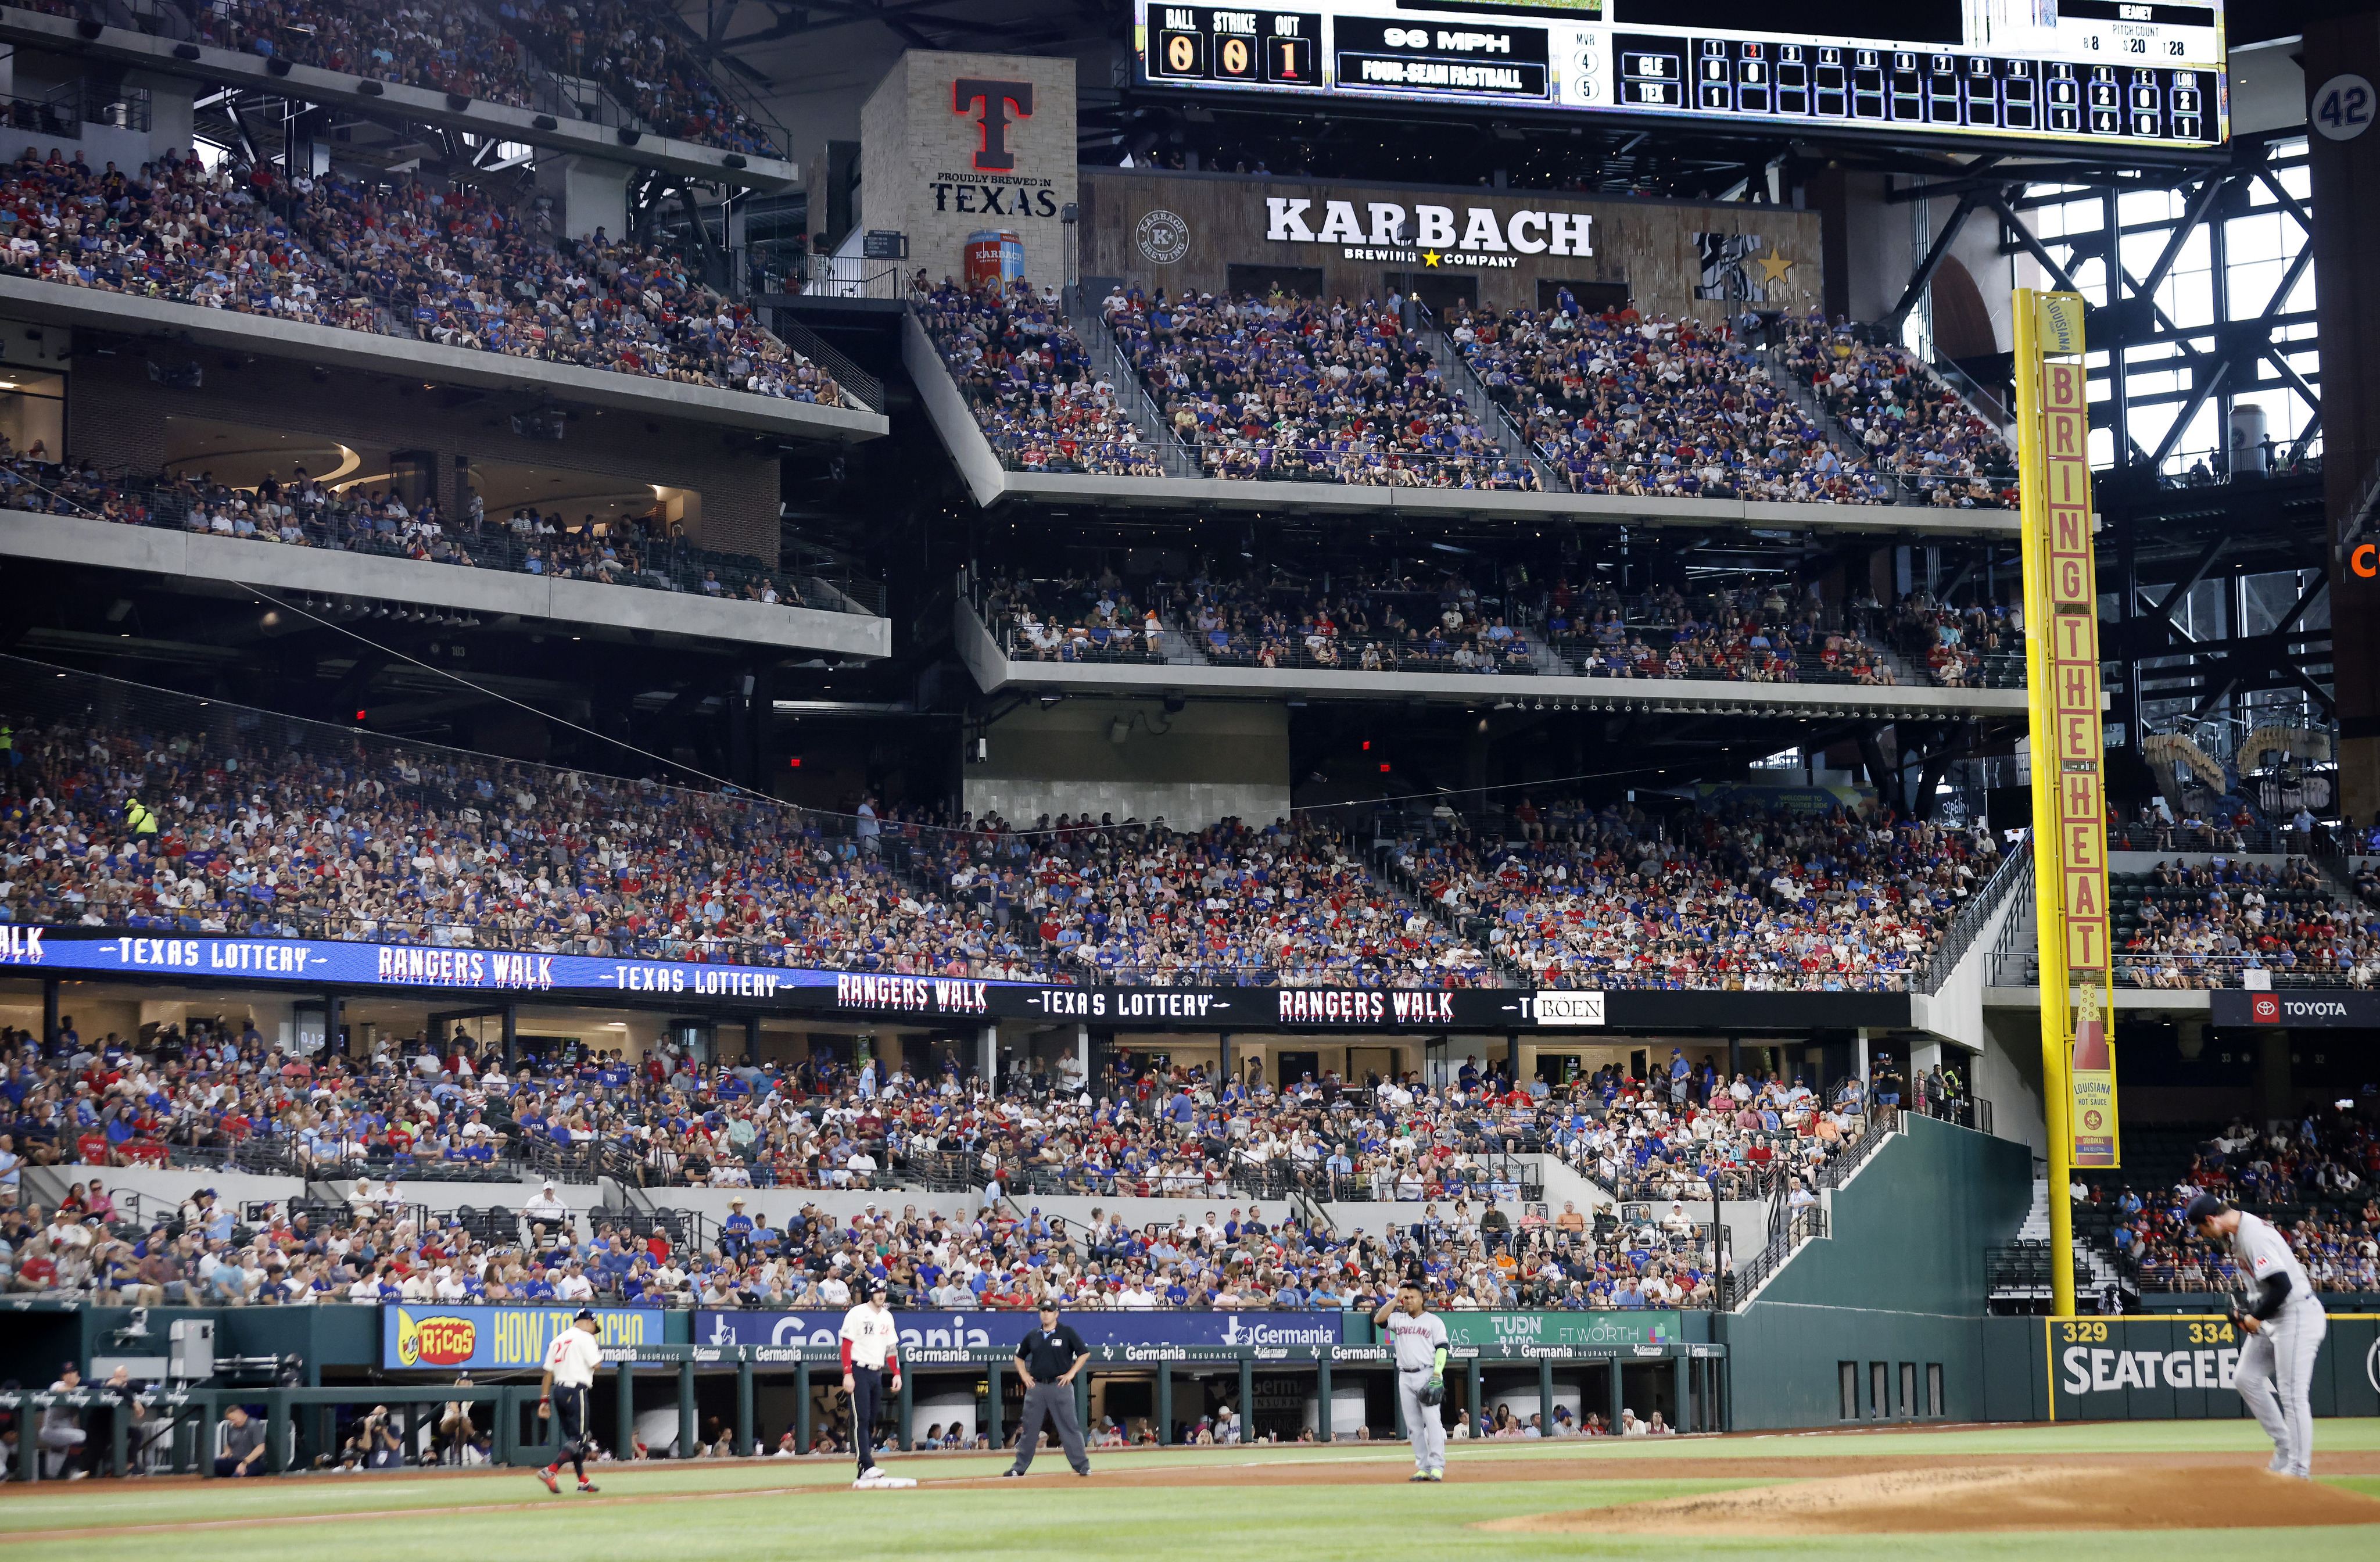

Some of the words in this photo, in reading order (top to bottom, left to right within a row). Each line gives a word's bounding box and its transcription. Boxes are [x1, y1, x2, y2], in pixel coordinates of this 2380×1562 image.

[1166, 9, 1196, 30] BALL
[1213, 13, 1256, 34] STRIKE
[1275, 16, 1299, 37] OUT
[2113, 24, 2134, 36] PITCH
[2135, 26, 2159, 37] COUNT
[1383, 27, 1429, 46] 96
[1437, 31, 1510, 53] MPH
[1576, 33, 1596, 46] MVR
[2092, 36, 2099, 50] 8
[2131, 38, 2146, 53] 20
[2170, 41, 2185, 56] 28
[1169, 35, 1193, 71] 0
[1223, 38, 1248, 74] 0
[1281, 42, 1298, 78] 1
[1582, 54, 1590, 69] 4
[1711, 42, 1717, 55] 1
[1750, 45, 1757, 57] 2
[1826, 49, 1833, 62] 4
[1940, 58, 1946, 70] 7
[2142, 70, 2148, 84] E
[2177, 72, 2193, 87] LOB
[1362, 59, 1450, 84] FOUR-SEAM
[1450, 65, 1522, 89] FASTBALL
[1639, 56, 1664, 76] CLE
[1709, 60, 1720, 80] 0
[1748, 63, 1759, 82] 0
[2059, 84, 2069, 102] 0
[2099, 87, 2110, 105] 2
[2139, 89, 2150, 108] 0
[2180, 92, 2189, 110] 2
[1583, 81, 1590, 96] 5
[1639, 84, 1664, 103] TEX
[1711, 87, 1719, 106] 1
[2061, 109, 2069, 128] 1
[2101, 112, 2110, 130] 4
[2141, 114, 2150, 134] 0
[2183, 117, 2190, 136] 1
[2319, 85, 2368, 128] 42
[954, 78, 1033, 171] T
[938, 172, 988, 183] PROUDLY
[991, 175, 1037, 187] BREWED
[1040, 178, 1052, 187] IN
[930, 182, 1056, 217] TEXAS
[1140, 213, 1185, 234] KARBACH
[1266, 197, 1593, 257] KARBACH
[1153, 229, 1169, 245] K
[976, 250, 1022, 261] KARBACH
[1141, 240, 1185, 261] BREWING
[1344, 248, 1417, 262] BREWING
[1444, 253, 1518, 267] COMPANY
[2046, 300, 2070, 352] LOUISIANA
[2053, 367, 2081, 598] BRING
[2351, 543, 2380, 578] C
[2064, 619, 2087, 755] THE
[2069, 777, 2095, 963] HEAT
[119, 937, 199, 966] TEXAS
[211, 943, 307, 972] LOTTERY
[378, 947, 485, 982] RANGERS
[492, 954, 554, 987] WALK
[616, 966, 684, 993] TEXAS
[695, 970, 776, 998] LOTTERY
[837, 975, 928, 1006] RANGERS
[935, 979, 988, 1010] WALK
[1041, 990, 1106, 1016] TEXAS
[1119, 993, 1209, 1017] LOTTERY
[1279, 991, 1385, 1018] RANGERS
[1392, 991, 1454, 1019] WALK
[1541, 996, 1601, 1017] BÖEN
[2284, 1002, 2347, 1016] TOYOTA
[2073, 1081, 2110, 1096] LOUISIANA
[2078, 1098, 2089, 1106] HOT
[2090, 1098, 2107, 1106] SAUCE
[2082, 1137, 2105, 1145] ORIGINAL
[2173, 1210, 2182, 1219] T
[1254, 1324, 1333, 1345] Germania
[1395, 1326, 1431, 1339] CLEVELAND
[1490, 1316, 1542, 1335] TUDN
[1560, 1327, 1574, 1342] FT
[1577, 1327, 1639, 1342] WORTH
[2062, 1322, 2107, 1343] 329
[2188, 1323, 2234, 1344] 334
[494, 1311, 544, 1364] HOW
[553, 1338, 573, 1364] 27
[639, 1353, 680, 1361] INSURANCE
[755, 1345, 802, 1362] Germania
[803, 1352, 841, 1361] INSURANCE
[905, 1346, 970, 1363] Germania
[1126, 1345, 1186, 1361] Germania
[1331, 1345, 1386, 1361] Germania
[1521, 1344, 1572, 1358] Germania
[2063, 1346, 2278, 1395] SEATGEE
